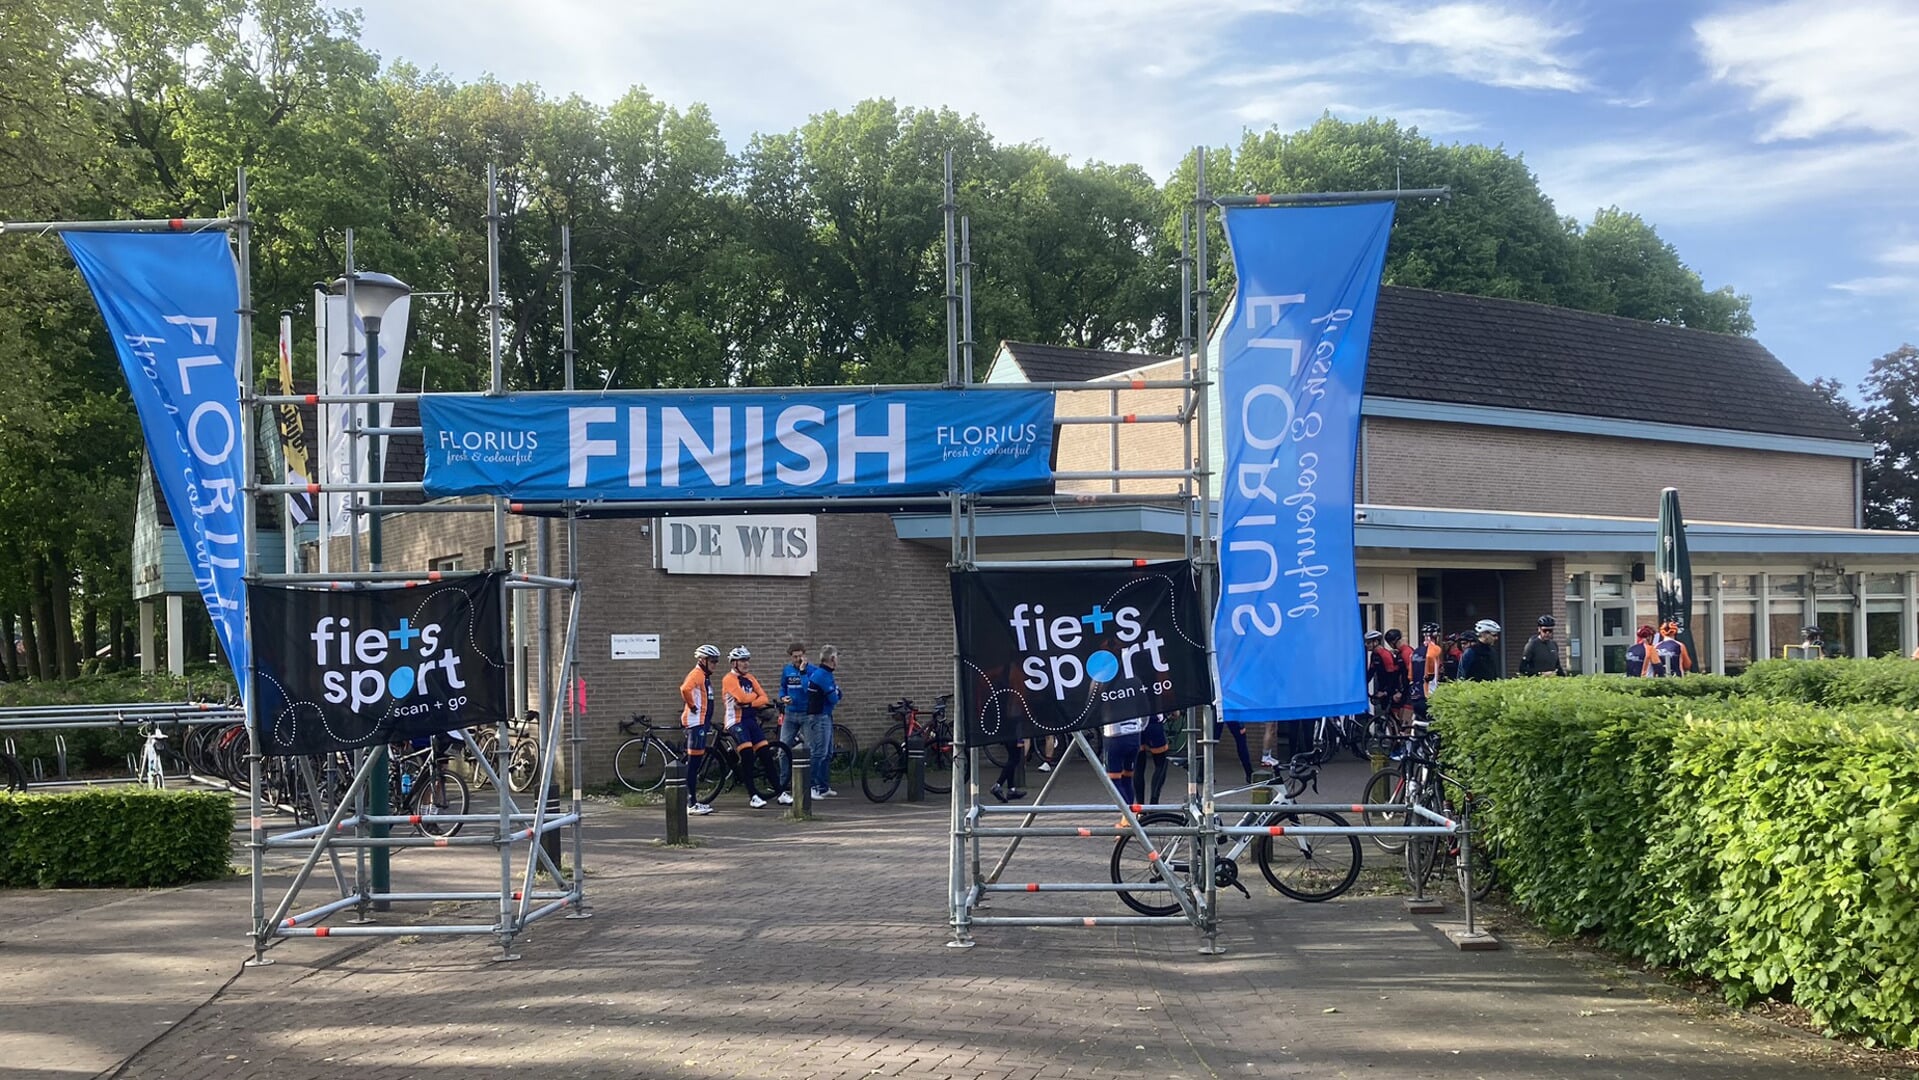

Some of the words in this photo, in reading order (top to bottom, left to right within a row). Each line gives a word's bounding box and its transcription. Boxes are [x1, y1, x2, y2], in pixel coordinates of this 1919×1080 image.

[439, 431, 538, 450] FLORIUS
[568, 403, 906, 488] FINISH
[937, 424, 1037, 446] FLORIUS
[471, 452, 481, 462] &
[483, 451, 533, 465] colourful
[943, 445, 969, 461] fresh
[972, 447, 981, 456] &
[983, 444, 1031, 459] colourful
[670, 523, 722, 556] DE
[735, 525, 808, 558] WIS
[1101, 686, 1135, 702] scan
[1153, 680, 1172, 695] go
[393, 702, 429, 717] scan
[448, 695, 467, 711] go
